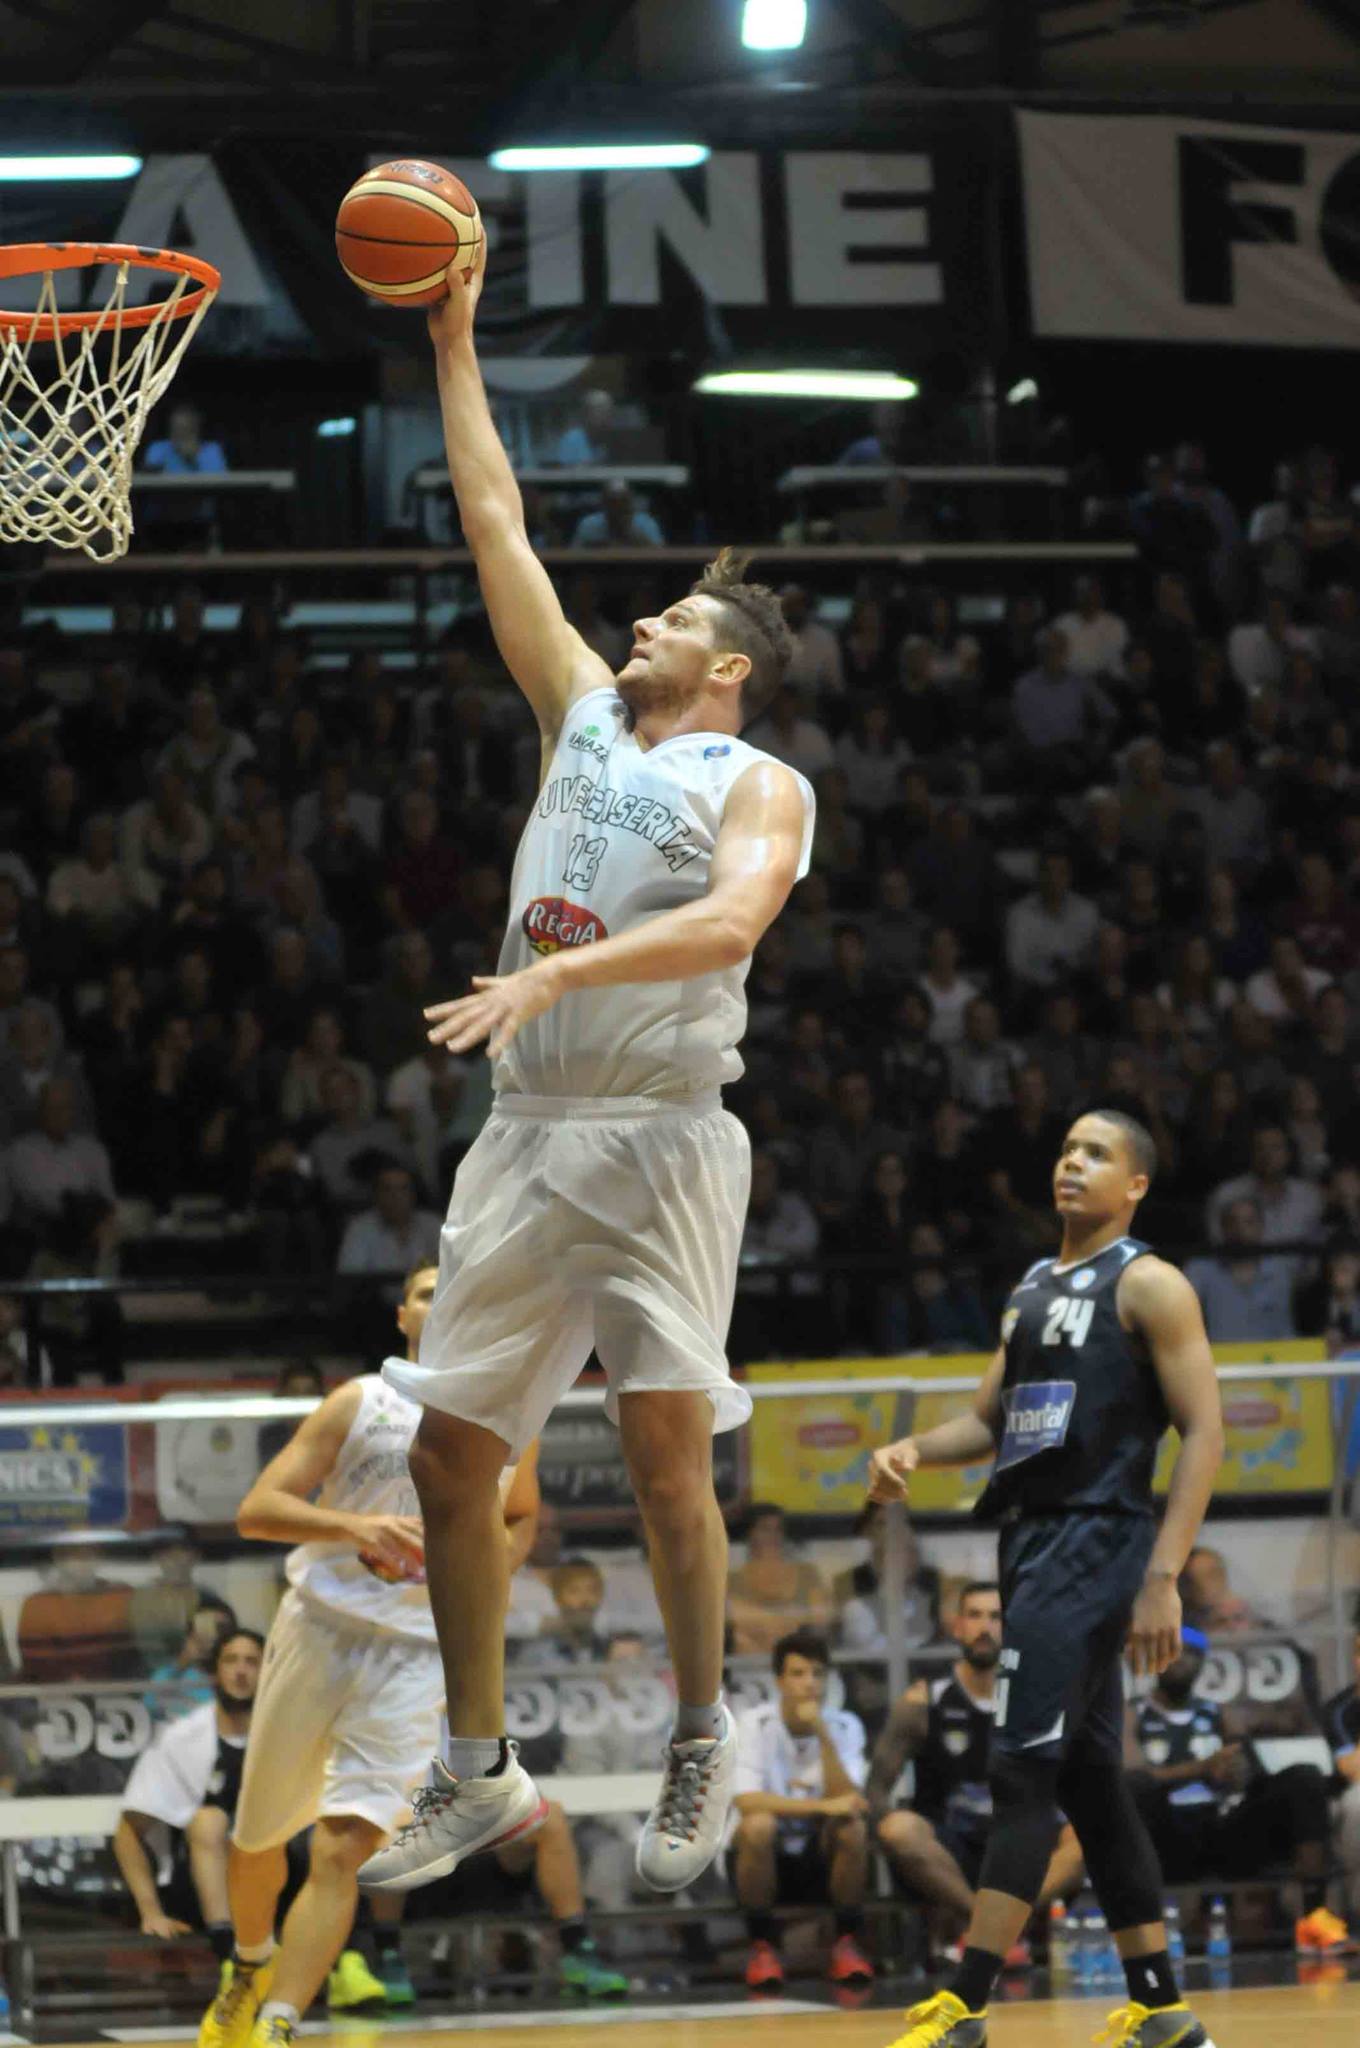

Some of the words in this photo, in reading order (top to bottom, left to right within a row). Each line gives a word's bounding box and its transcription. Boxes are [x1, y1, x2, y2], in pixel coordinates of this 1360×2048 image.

[563, 833, 608, 892] 13
[528, 902, 597, 945] REGIA
[1041, 1295, 1096, 1348] 24
